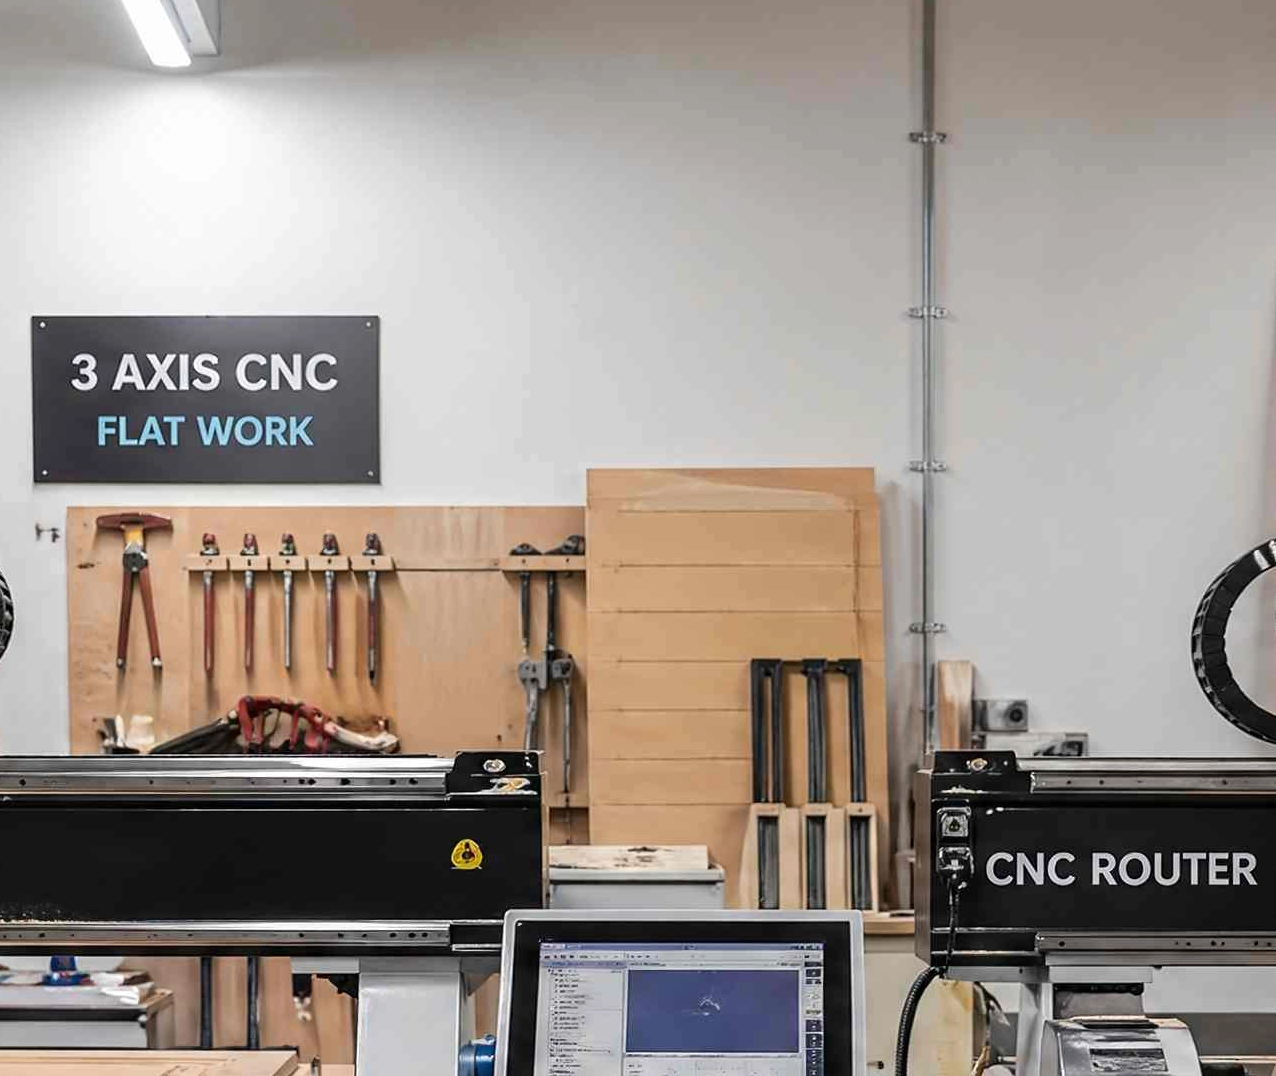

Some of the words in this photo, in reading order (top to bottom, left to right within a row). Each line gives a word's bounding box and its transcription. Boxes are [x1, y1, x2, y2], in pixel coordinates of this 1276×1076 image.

[71, 354, 98, 391] 3
[112, 353, 220, 391] AXIS
[236, 353, 338, 391] CNC
[98, 416, 185, 446] FLAT
[196, 416, 314, 446] WORK
[986, 852, 1075, 886] CNC
[1092, 852, 1258, 886] ROUTER
